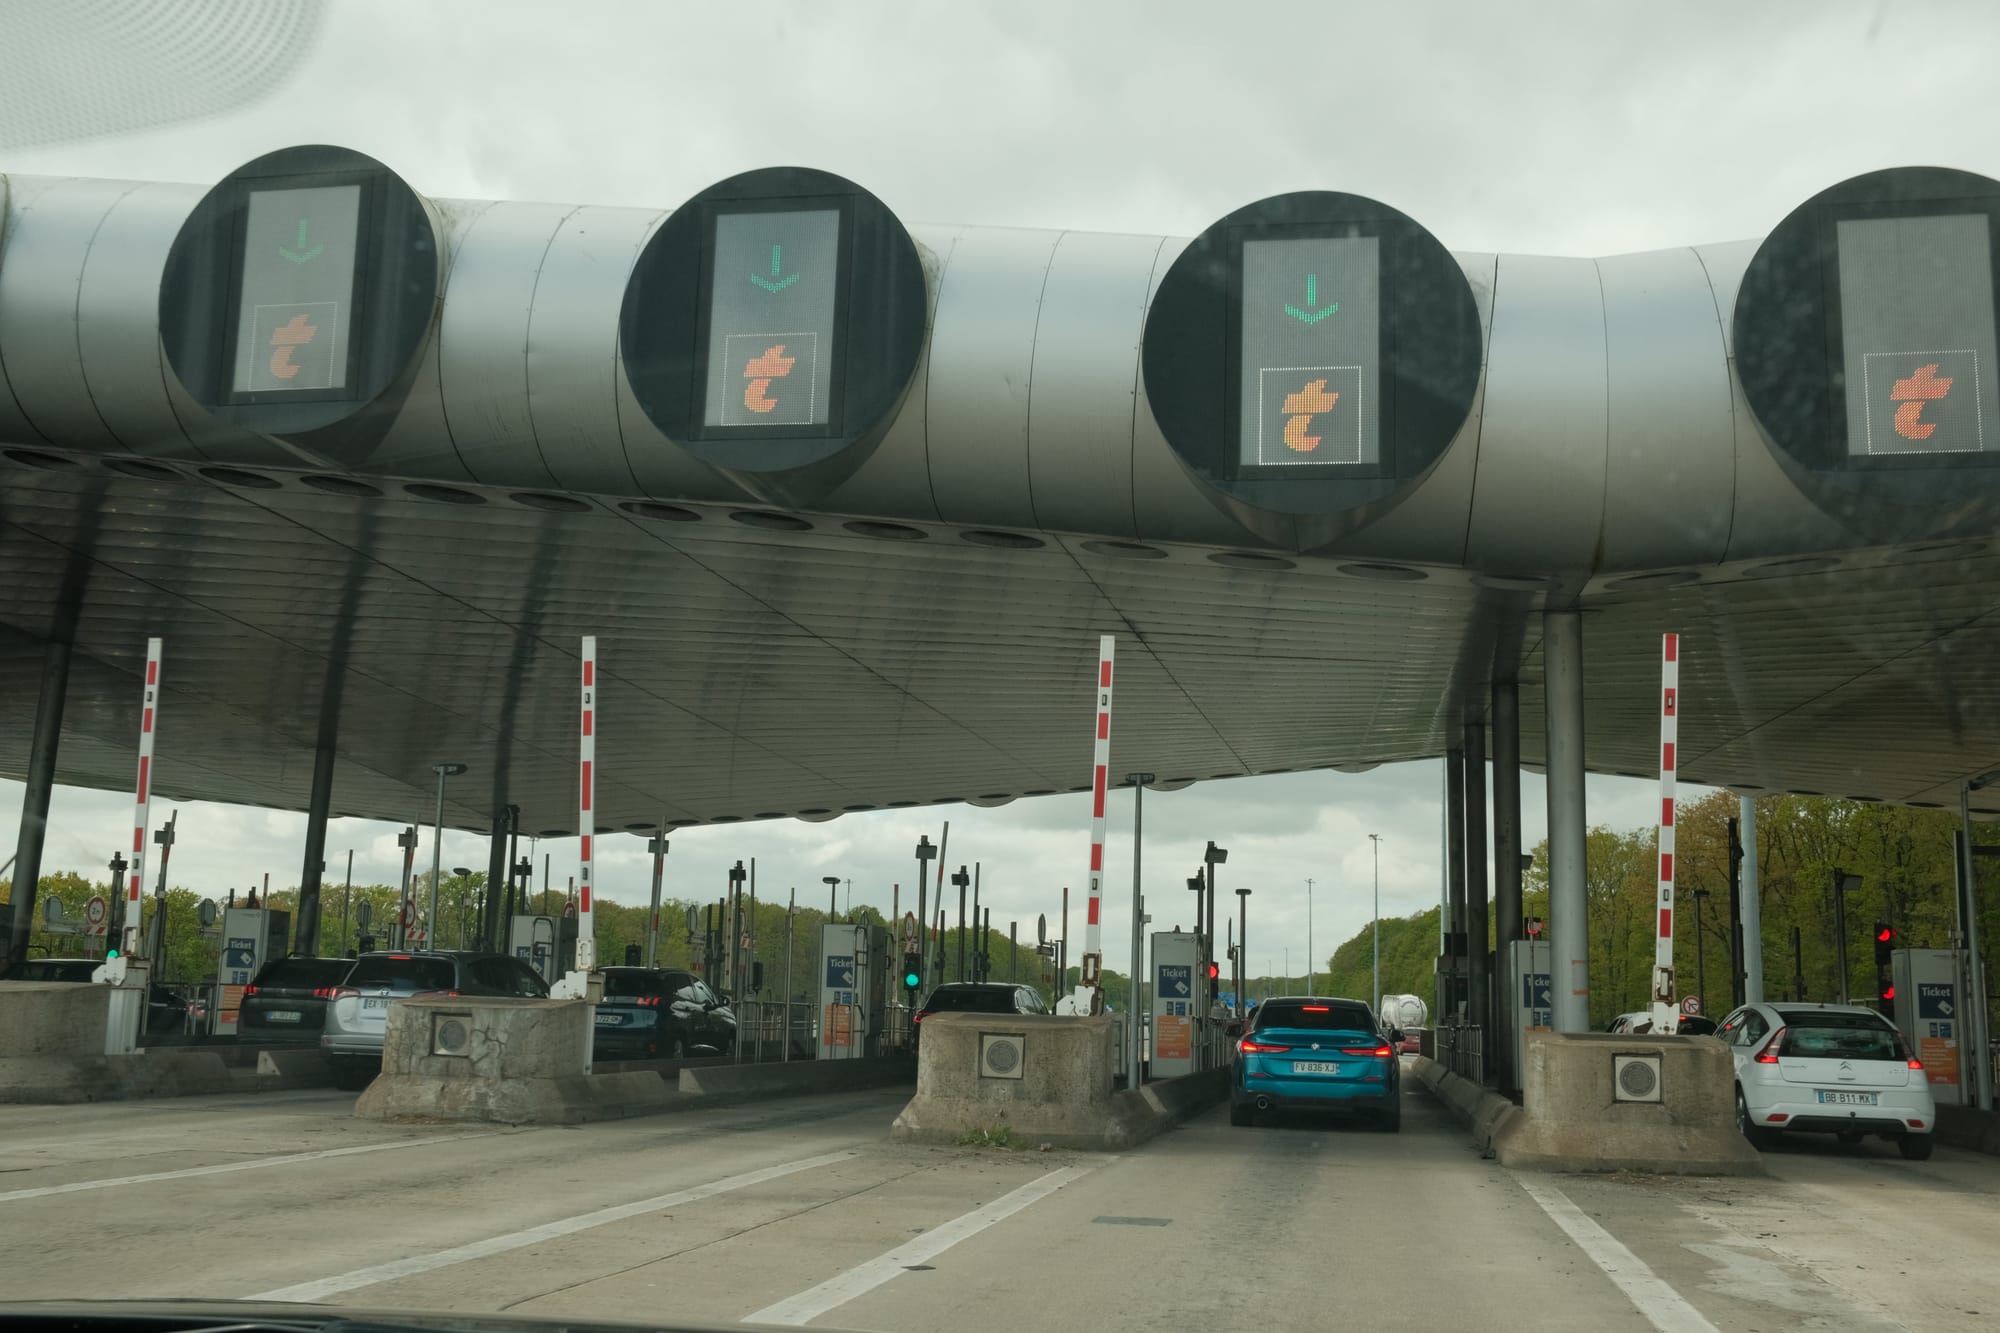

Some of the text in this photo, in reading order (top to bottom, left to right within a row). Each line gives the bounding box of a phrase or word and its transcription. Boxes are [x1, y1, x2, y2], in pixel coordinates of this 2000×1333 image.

[231, 941, 252, 950] Ticket
[830, 958, 853, 968] Ticket
[1162, 968, 1187, 978] Ticket
[1921, 986, 1951, 997] Ticket
[1295, 1062, 1335, 1073] FV-836-XJ
